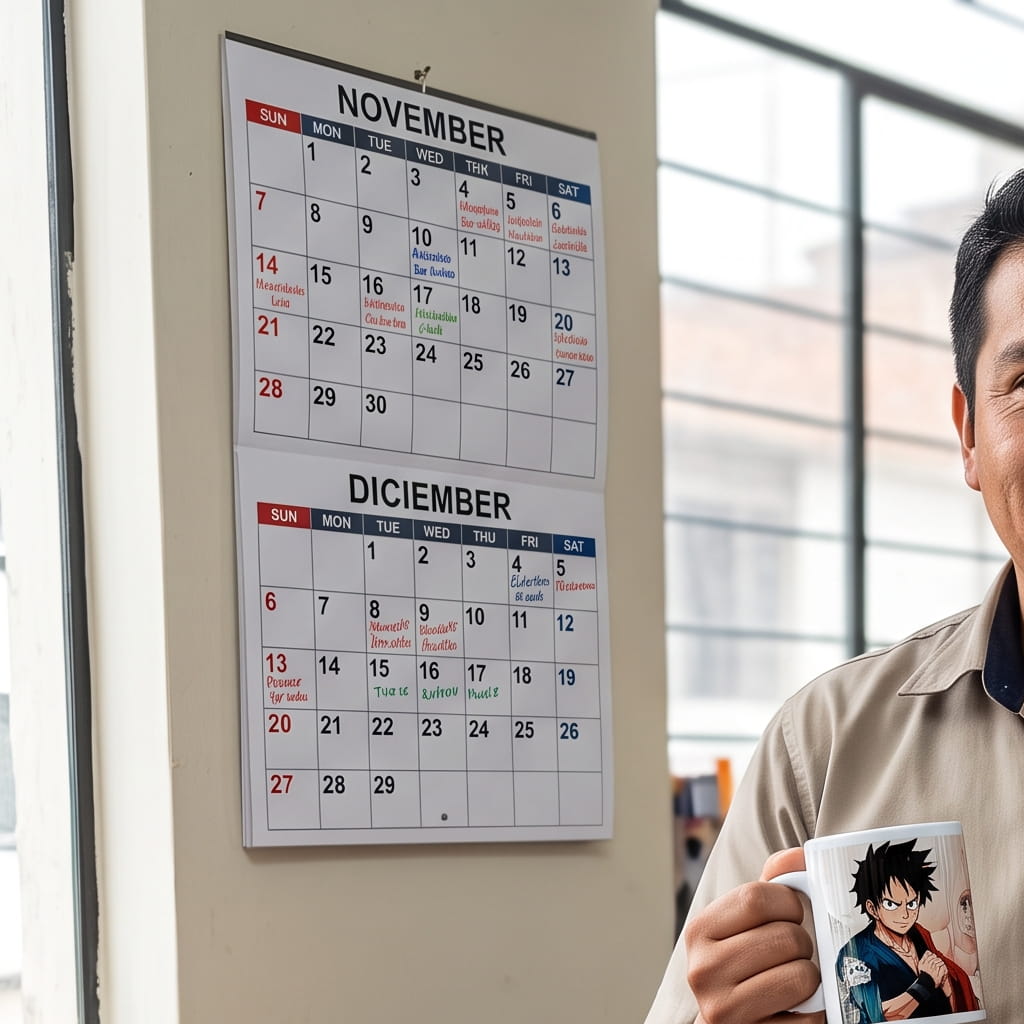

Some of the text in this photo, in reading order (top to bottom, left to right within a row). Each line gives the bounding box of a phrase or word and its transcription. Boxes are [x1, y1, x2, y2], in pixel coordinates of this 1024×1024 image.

[337, 84, 506, 156] NOVEMBER
[260, 109, 287, 126] SUN
[313, 121, 342, 139] MON
[367, 135, 392, 152] TUE
[416, 147, 444, 165] WED
[515, 172, 532, 186] FRI
[558, 183, 580, 197] SAT
[307, 142, 315, 161] 1
[360, 155, 372, 175] 2
[410, 168, 421, 186] 3
[459, 180, 469, 198] 4
[506, 192, 516, 210] 5
[551, 202, 561, 220] 6
[255, 190, 267, 210] 7
[311, 203, 321, 222] 8
[362, 215, 373, 234] 9
[412, 226, 432, 247] 10
[460, 237, 477, 257] 11
[507, 247, 526, 267] 12
[553, 257, 571, 276] 13
[256, 253, 278, 274] 14
[310, 264, 332, 285] 15
[363, 274, 384, 295] 16
[413, 284, 433, 305] 17
[462, 294, 481, 314] 18
[509, 304, 527, 323] 19
[554, 313, 573, 331] 20
[258, 315, 575, 387] 21 22 23 24 25 26 27
[259, 377, 387, 414] 28 29 30
[349, 474, 511, 520] DICIEMBER
[271, 508, 584, 553] SUN MON TUE WED THU FRI SAT
[367, 541, 566, 576] 1 2 3 4 5
[265, 591, 574, 632] 6 7 8 9 10 11 12
[266, 653, 576, 686] 13 14 15 16 17 18 19
[268, 714, 579, 739] 20 21 22 23 24 25 26
[270, 774, 395, 794] 27 28 29
